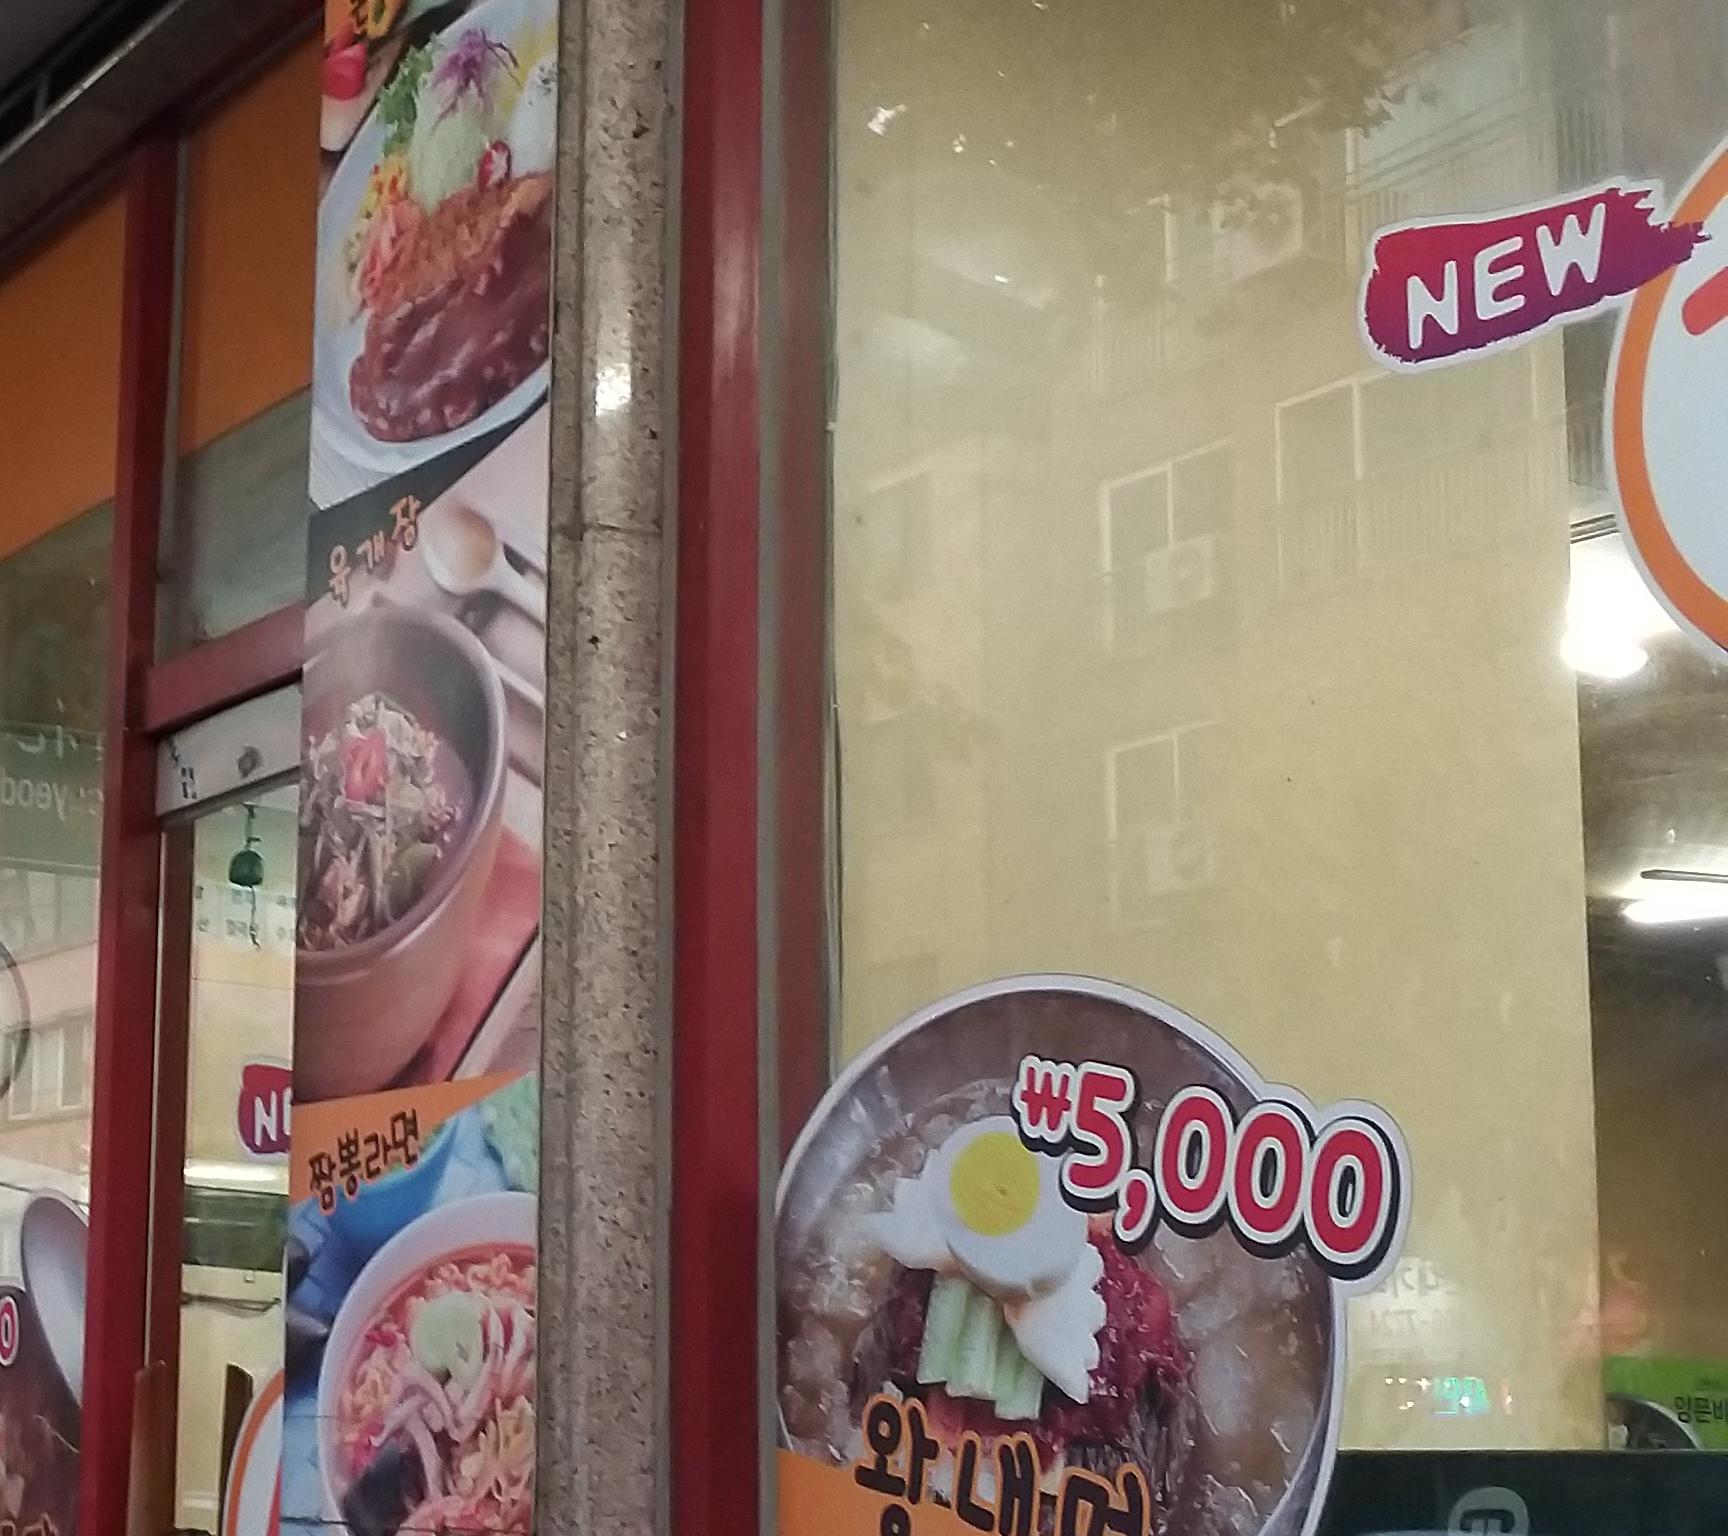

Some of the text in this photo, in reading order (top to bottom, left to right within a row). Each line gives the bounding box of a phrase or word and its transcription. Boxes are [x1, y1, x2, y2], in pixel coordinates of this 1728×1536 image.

[1405, 202, 1607, 350] NEW
[308, 1107, 421, 1211] 짬뽕라면
[1018, 1056, 1392, 1260] ₩5,000
